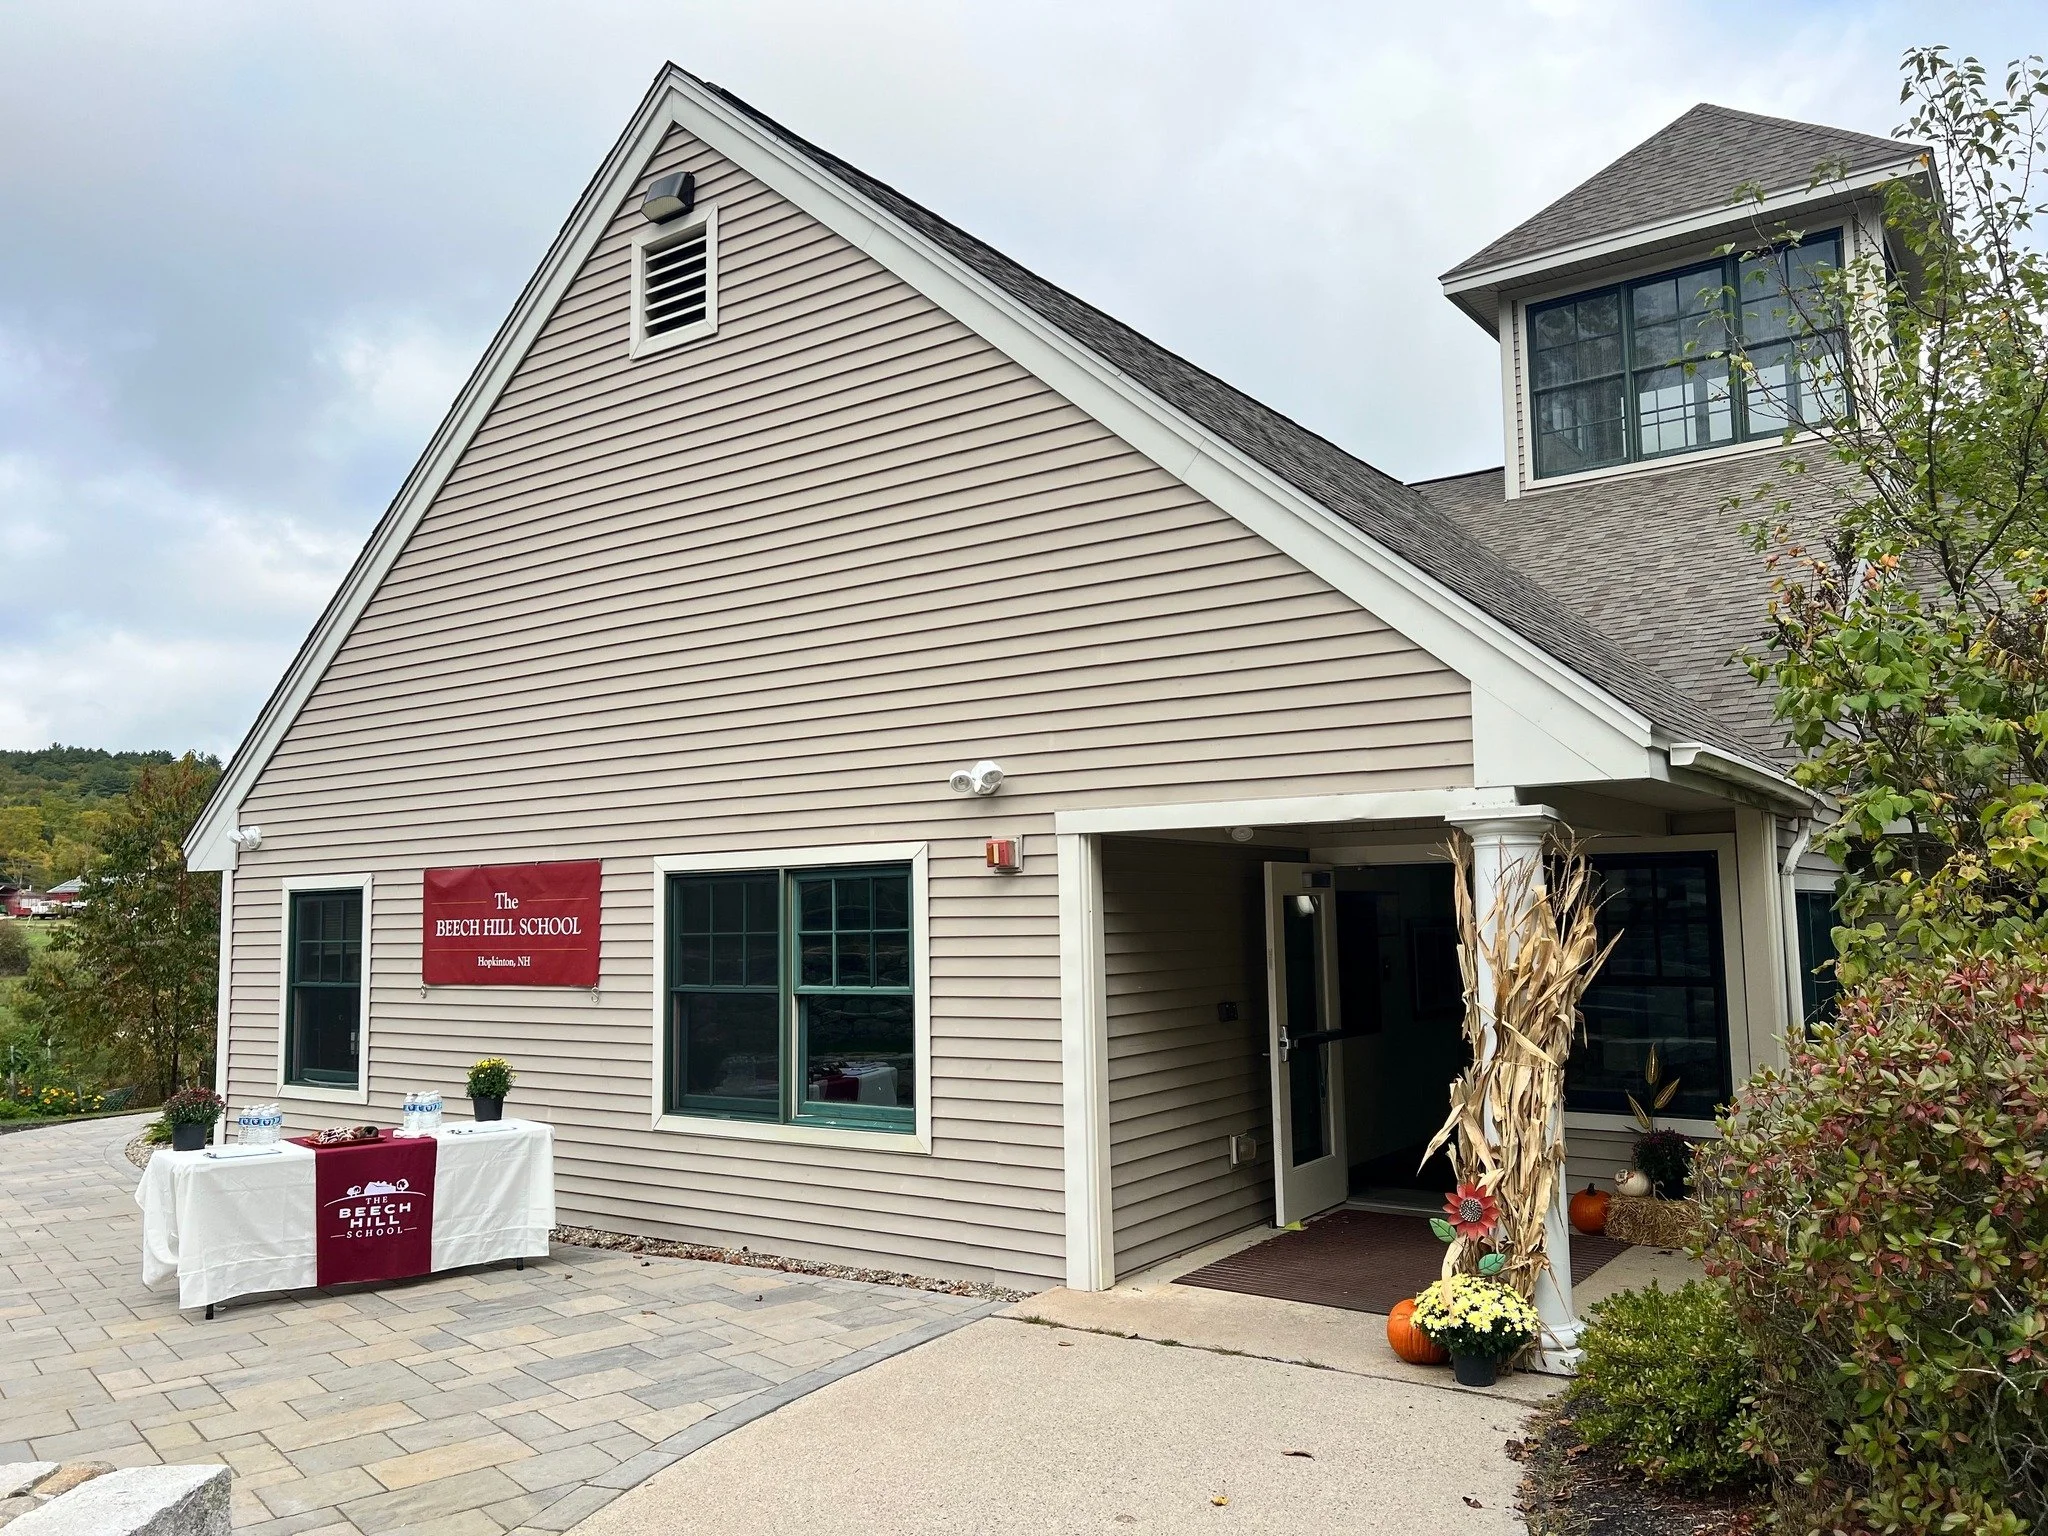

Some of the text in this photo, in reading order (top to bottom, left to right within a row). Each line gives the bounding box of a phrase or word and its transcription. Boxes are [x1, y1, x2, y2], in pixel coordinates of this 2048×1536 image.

[495, 892, 519, 909] The
[436, 916, 581, 936] BEECH HILL SCHOOL
[477, 956, 531, 968] Hopkinton, NH
[365, 1196, 388, 1205] THE
[339, 1202, 411, 1219] BEECH
[350, 1215, 400, 1228] HILL
[346, 1227, 403, 1239] SCHOOL
